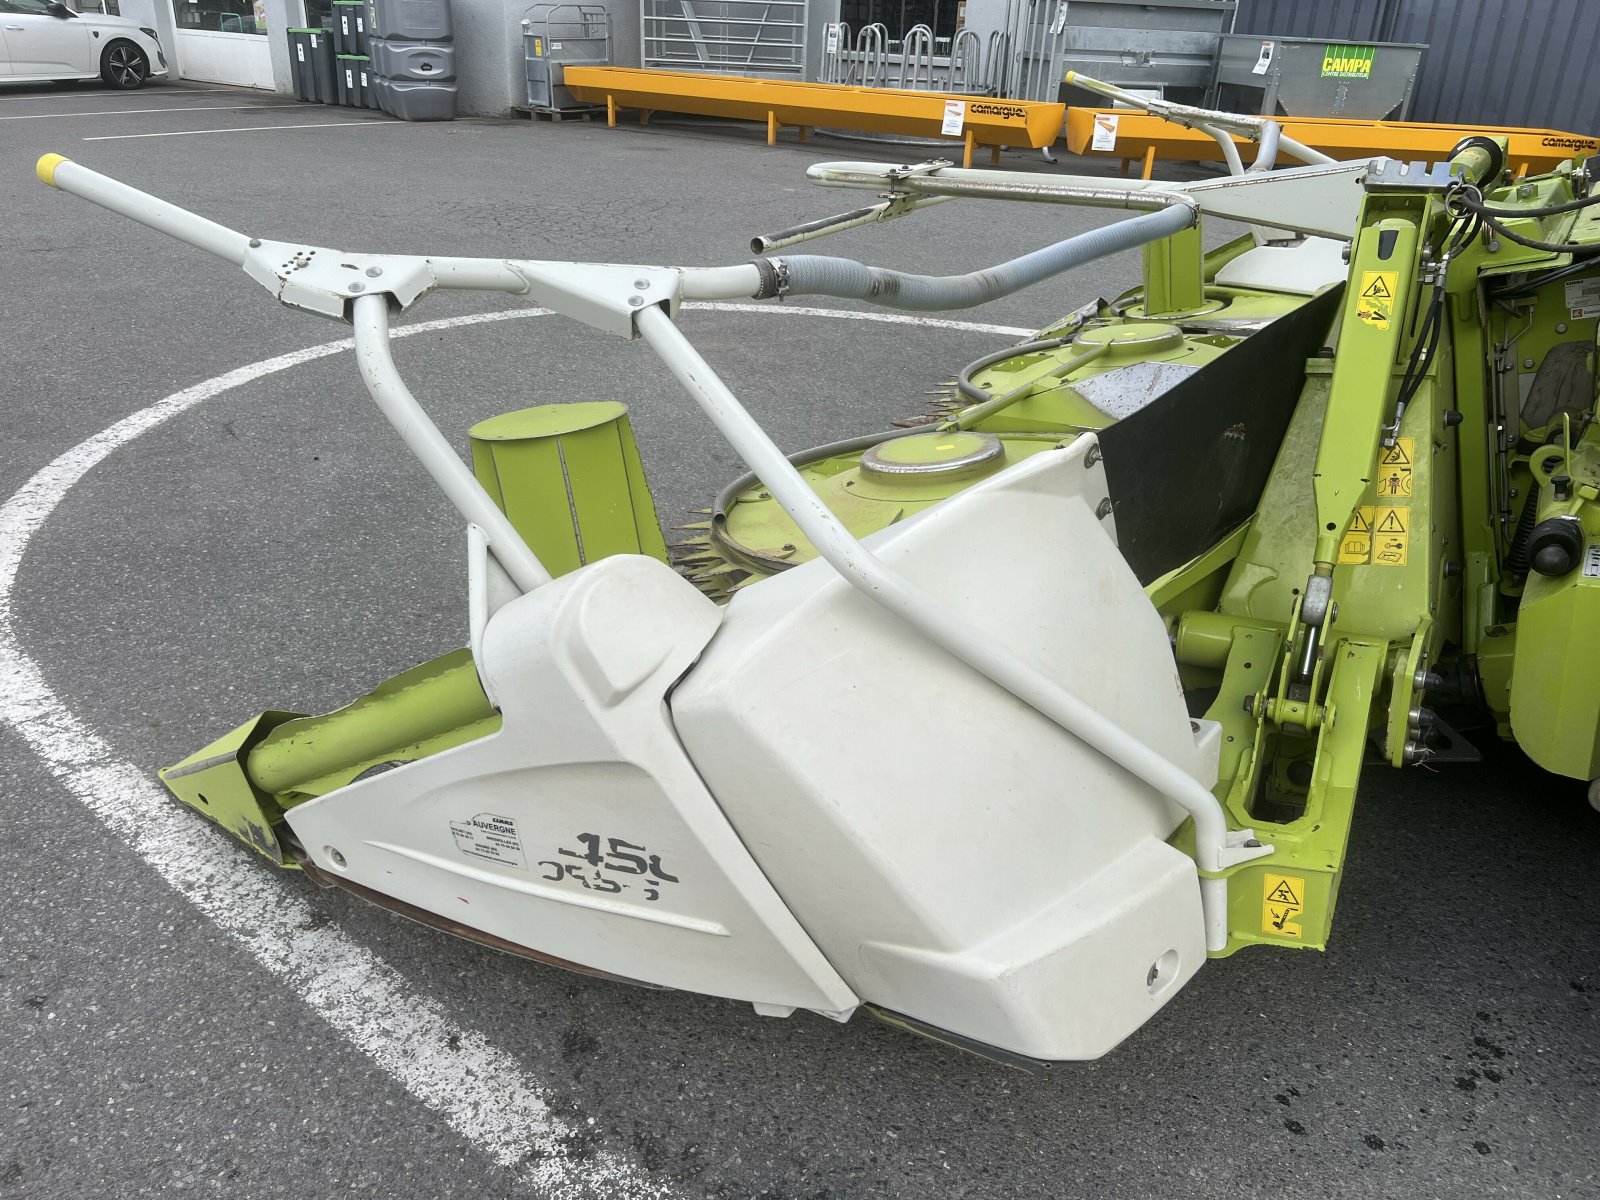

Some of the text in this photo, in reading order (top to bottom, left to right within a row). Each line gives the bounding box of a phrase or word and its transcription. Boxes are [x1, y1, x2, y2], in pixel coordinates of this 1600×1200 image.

[1322, 57, 1371, 73] CAMPA
[970, 104, 1026, 119] camargue
[1541, 137, 1598, 151] camargue
[473, 820, 517, 835] AUVERGNE
